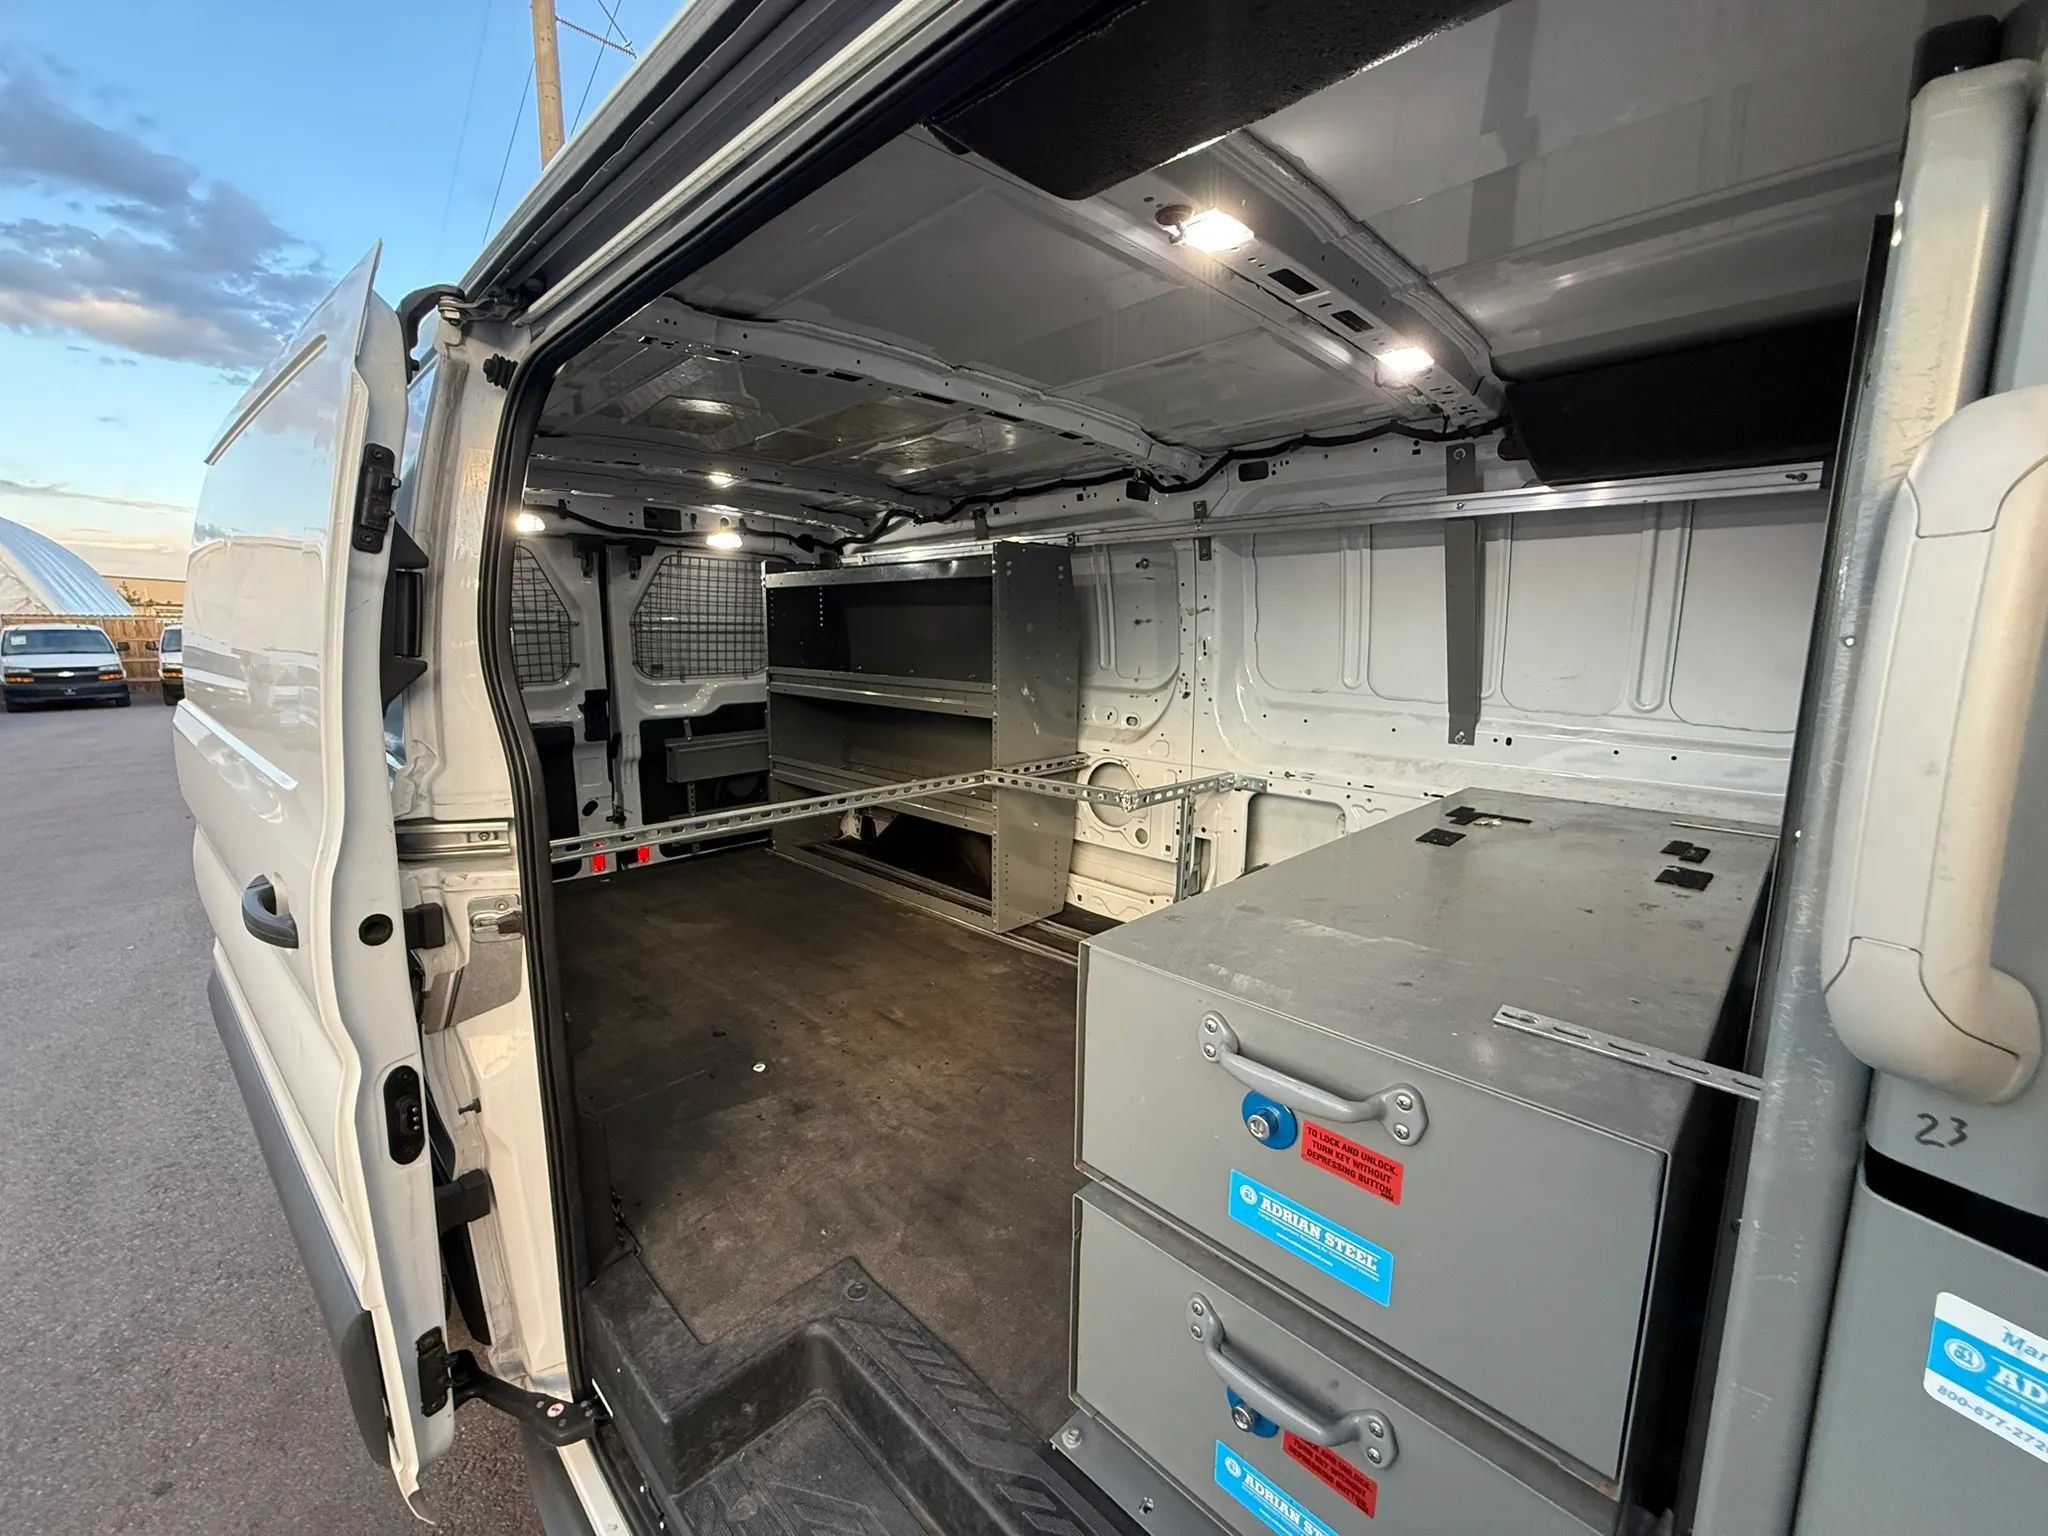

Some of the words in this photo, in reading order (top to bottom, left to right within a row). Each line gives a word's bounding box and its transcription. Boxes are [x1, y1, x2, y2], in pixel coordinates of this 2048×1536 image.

[1307, 1127, 1318, 1138] TO
[1319, 1131, 1340, 1149] LOCK
[1341, 1143, 1360, 1157] AND
[1915, 1113, 1968, 1148] 23
[1306, 1148, 1356, 1180] DEPRESSING
[1312, 1139, 1334, 1156] TURN
[1335, 1150, 1351, 1164] KEY
[1352, 1159, 1392, 1184] WITHOUT
[1260, 1197, 1321, 1241] ADRIAN
[1937, 1384, 2048, 1454] 800-677-272
[1244, 1473, 1301, 1526] ADRIAN
